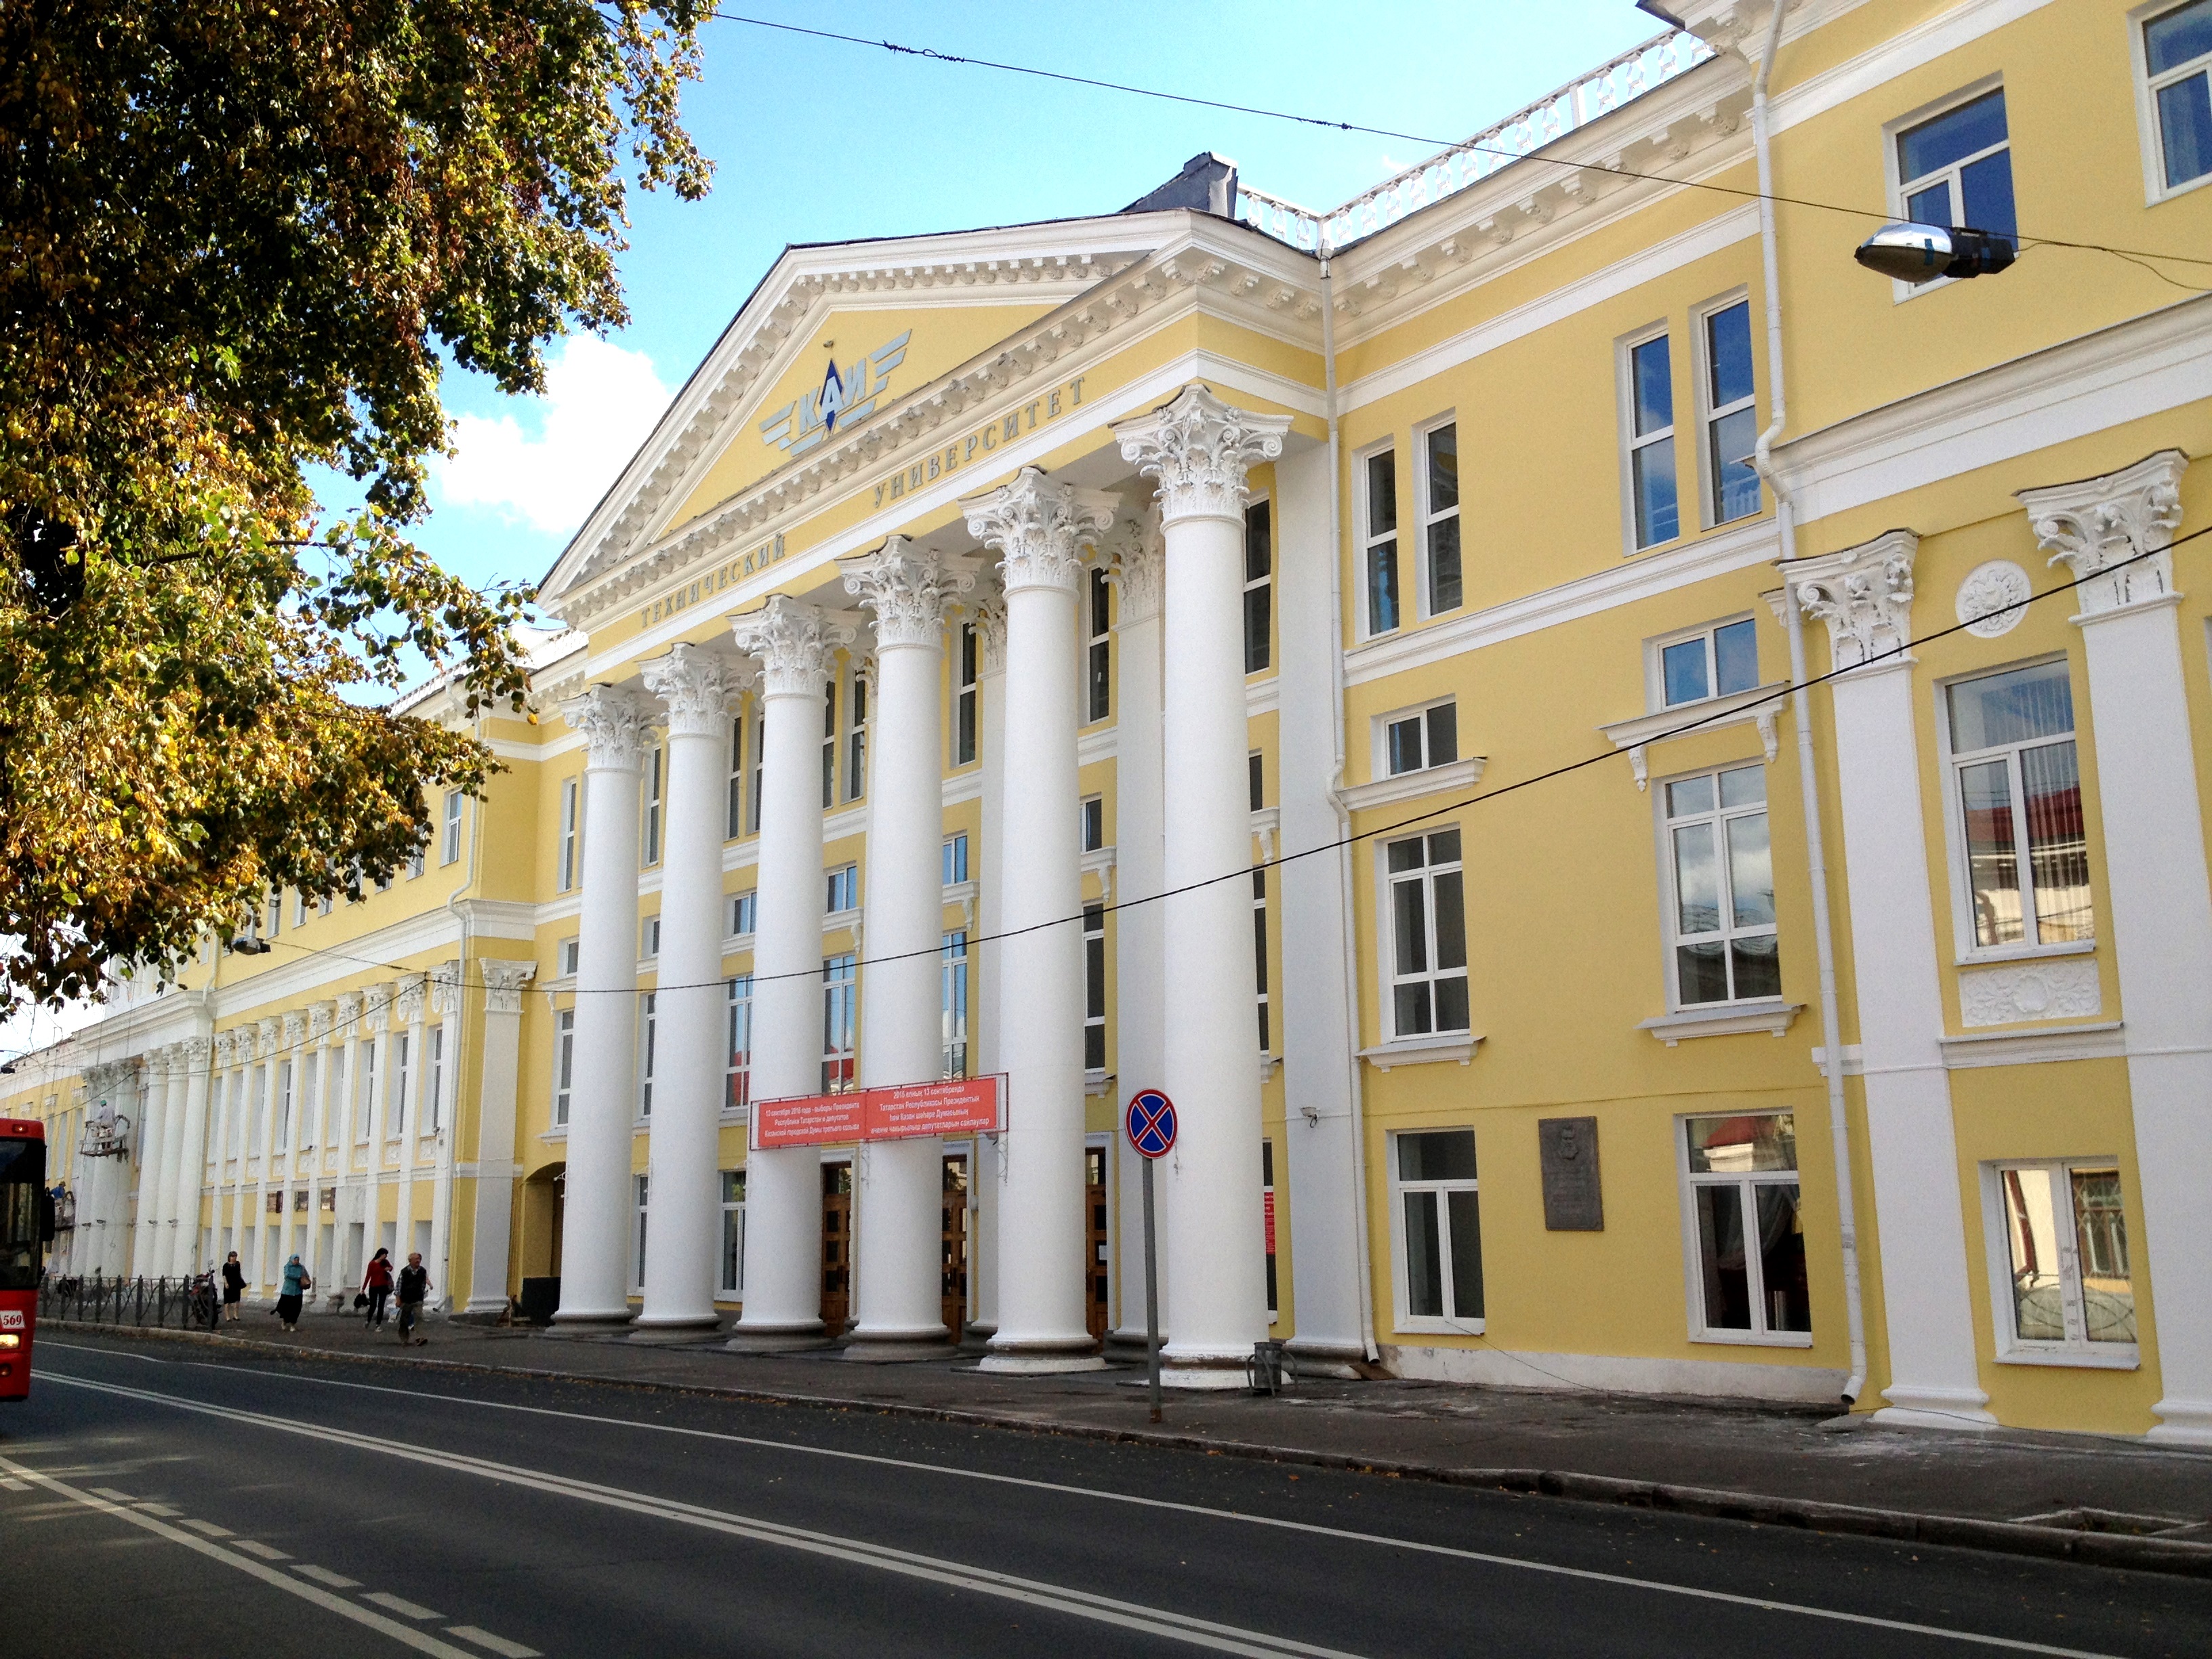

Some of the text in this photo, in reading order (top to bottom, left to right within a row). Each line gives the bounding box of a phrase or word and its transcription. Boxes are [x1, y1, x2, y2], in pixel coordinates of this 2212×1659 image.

[800, 357, 866, 436] КАИ
[641, 376, 1084, 628] ТЕХНИЧЕСКИЙ УНИВЕРСИТЕТ
